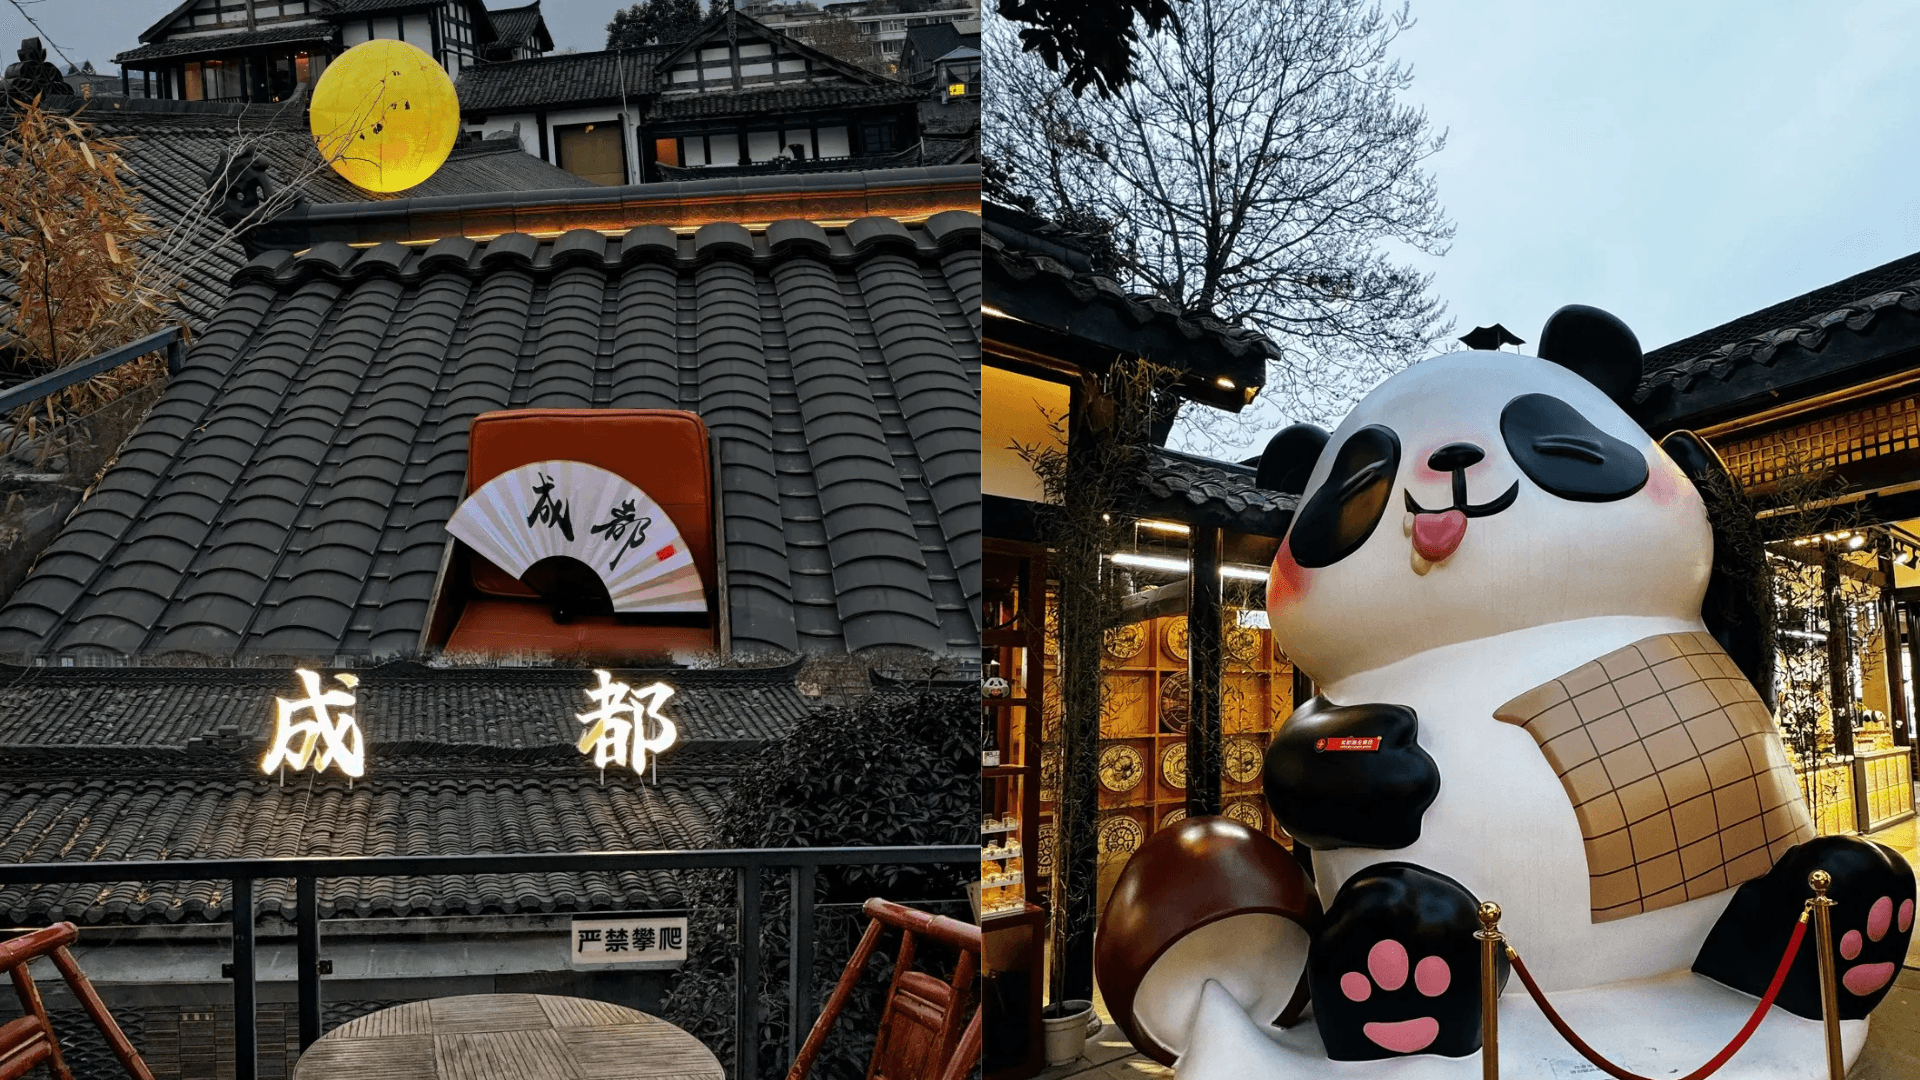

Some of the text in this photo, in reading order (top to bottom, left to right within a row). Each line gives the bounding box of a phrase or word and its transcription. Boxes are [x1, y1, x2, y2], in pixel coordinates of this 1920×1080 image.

[527, 472, 651, 571] 成都
[578, 926, 682, 953] 严禁攀爬
